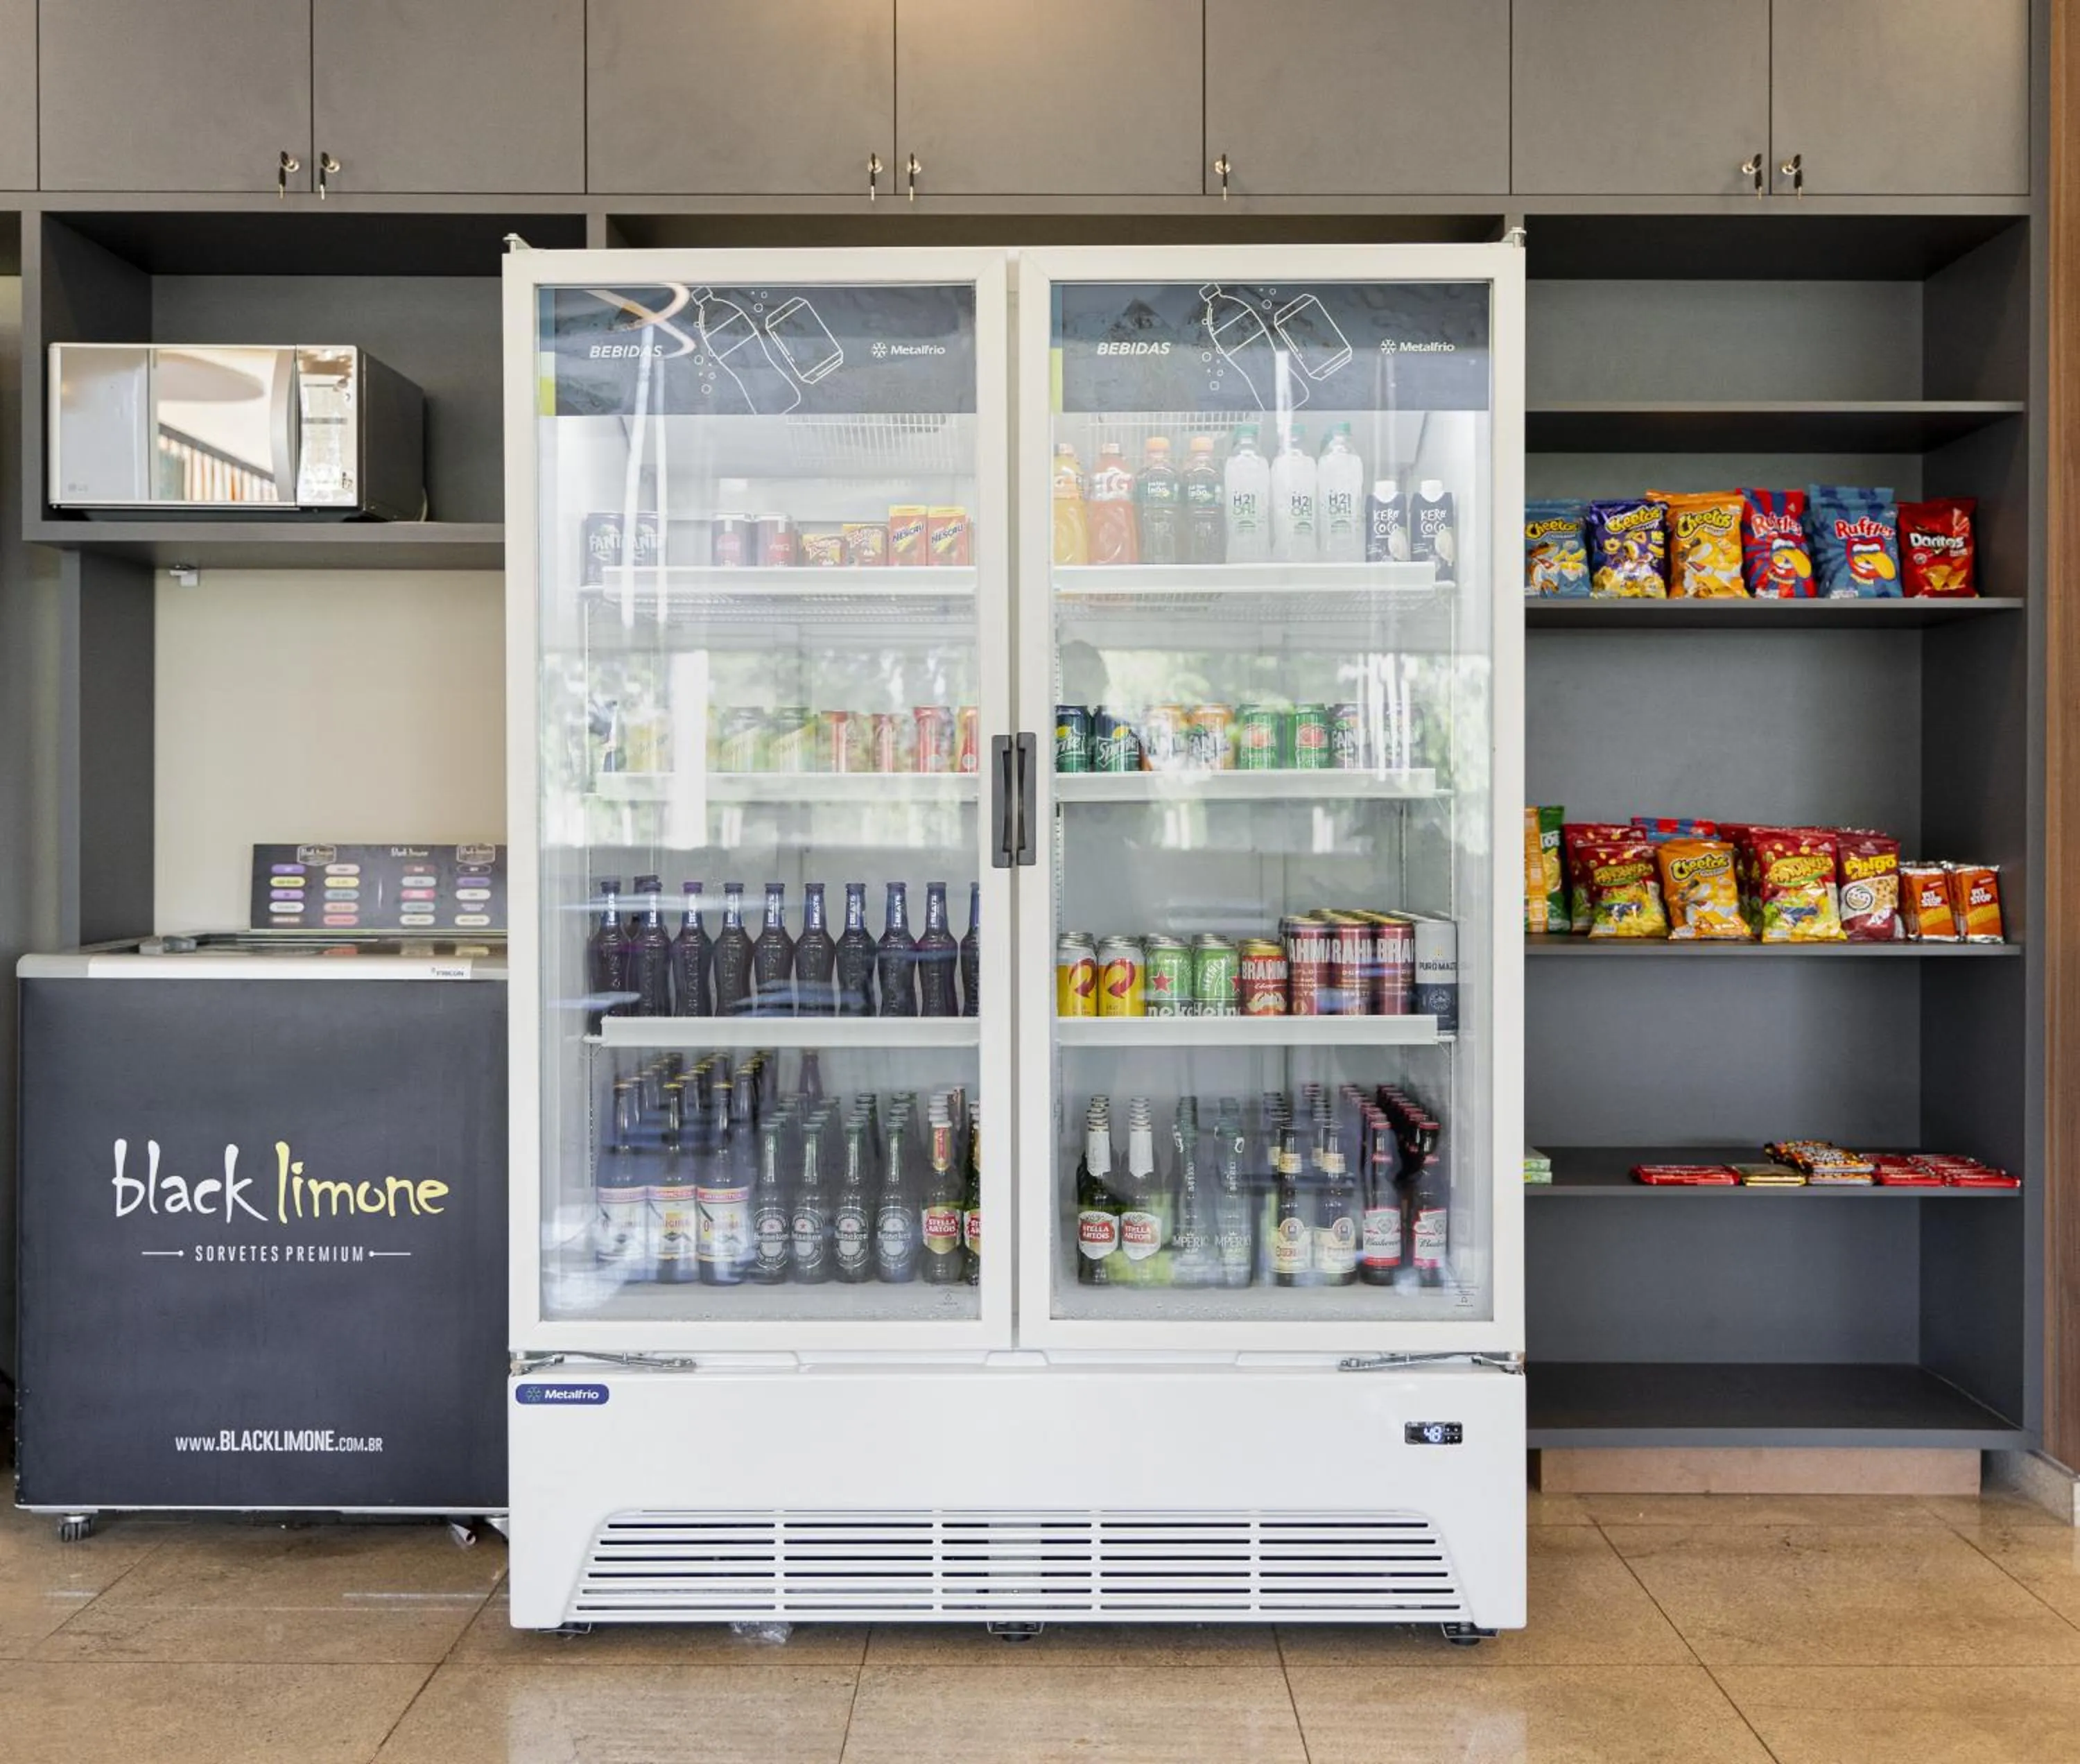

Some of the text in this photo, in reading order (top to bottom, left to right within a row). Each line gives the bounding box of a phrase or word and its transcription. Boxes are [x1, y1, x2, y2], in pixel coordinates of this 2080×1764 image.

[589, 345, 663, 359] BEBIDAS
[890, 345, 946, 356] Metalfrio
[1097, 341, 1171, 356] BEBIDAS
[1399, 341, 1455, 353] Metalfrio
[1373, 521, 1398, 535] COCO
[1421, 521, 1446, 535] COCO
[1676, 507, 1733, 539] Cheetos
[1835, 517, 1896, 539] Ruffles
[589, 532, 622, 552] FANT
[1909, 532, 1964, 548] Doritos
[1671, 854, 1730, 881] Cheetos
[1288, 938, 1331, 964] AHM
[1376, 938, 1414, 964] BRA
[1242, 960, 1288, 980] BRAHM
[112, 1139, 449, 1225] black limone
[195, 1245, 364, 1262] SORVETES PREMIUM
[544, 1389, 600, 1399] Metalfrio
